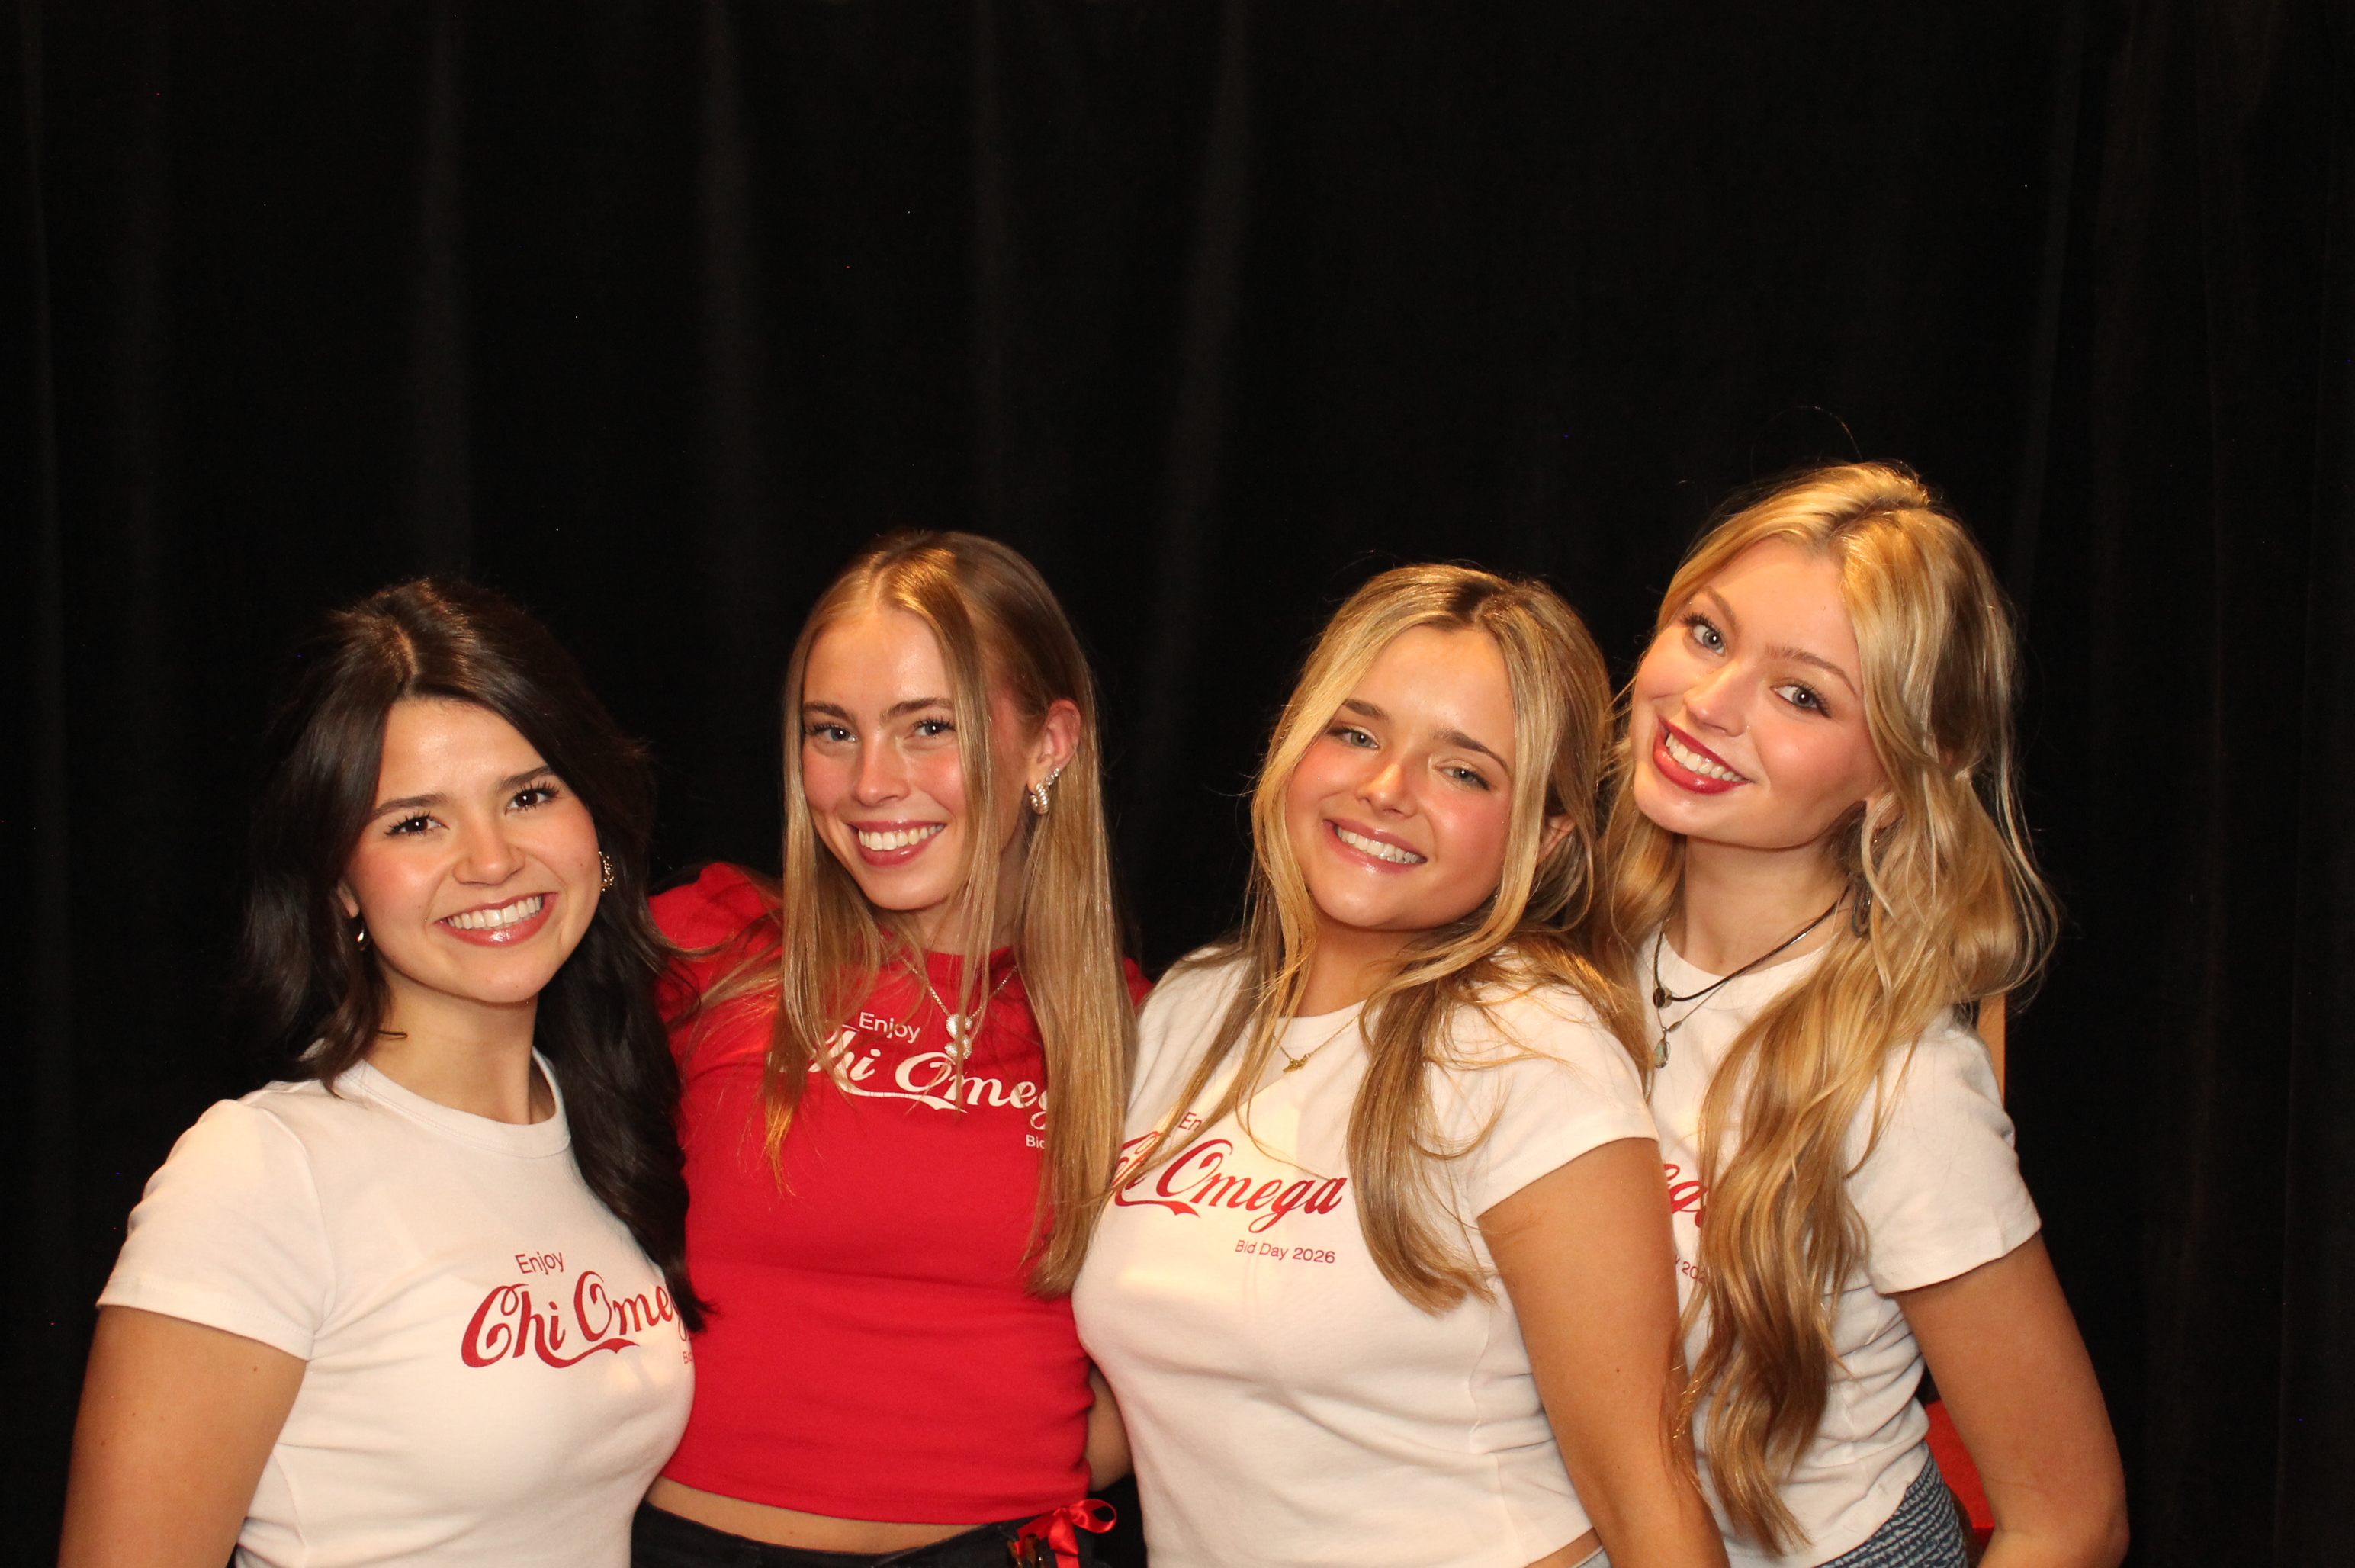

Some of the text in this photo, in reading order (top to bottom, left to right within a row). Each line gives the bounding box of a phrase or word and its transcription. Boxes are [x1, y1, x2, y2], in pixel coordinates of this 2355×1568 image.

[859, 1011, 920, 1044] Enjoy
[895, 1052, 1048, 1130] Ome
[1155, 1139, 1348, 1234] Omega
[515, 1251, 564, 1275] Enjoy
[1235, 1239, 1335, 1264] Bid Day 2026
[461, 1271, 687, 1368] Chi Ome
